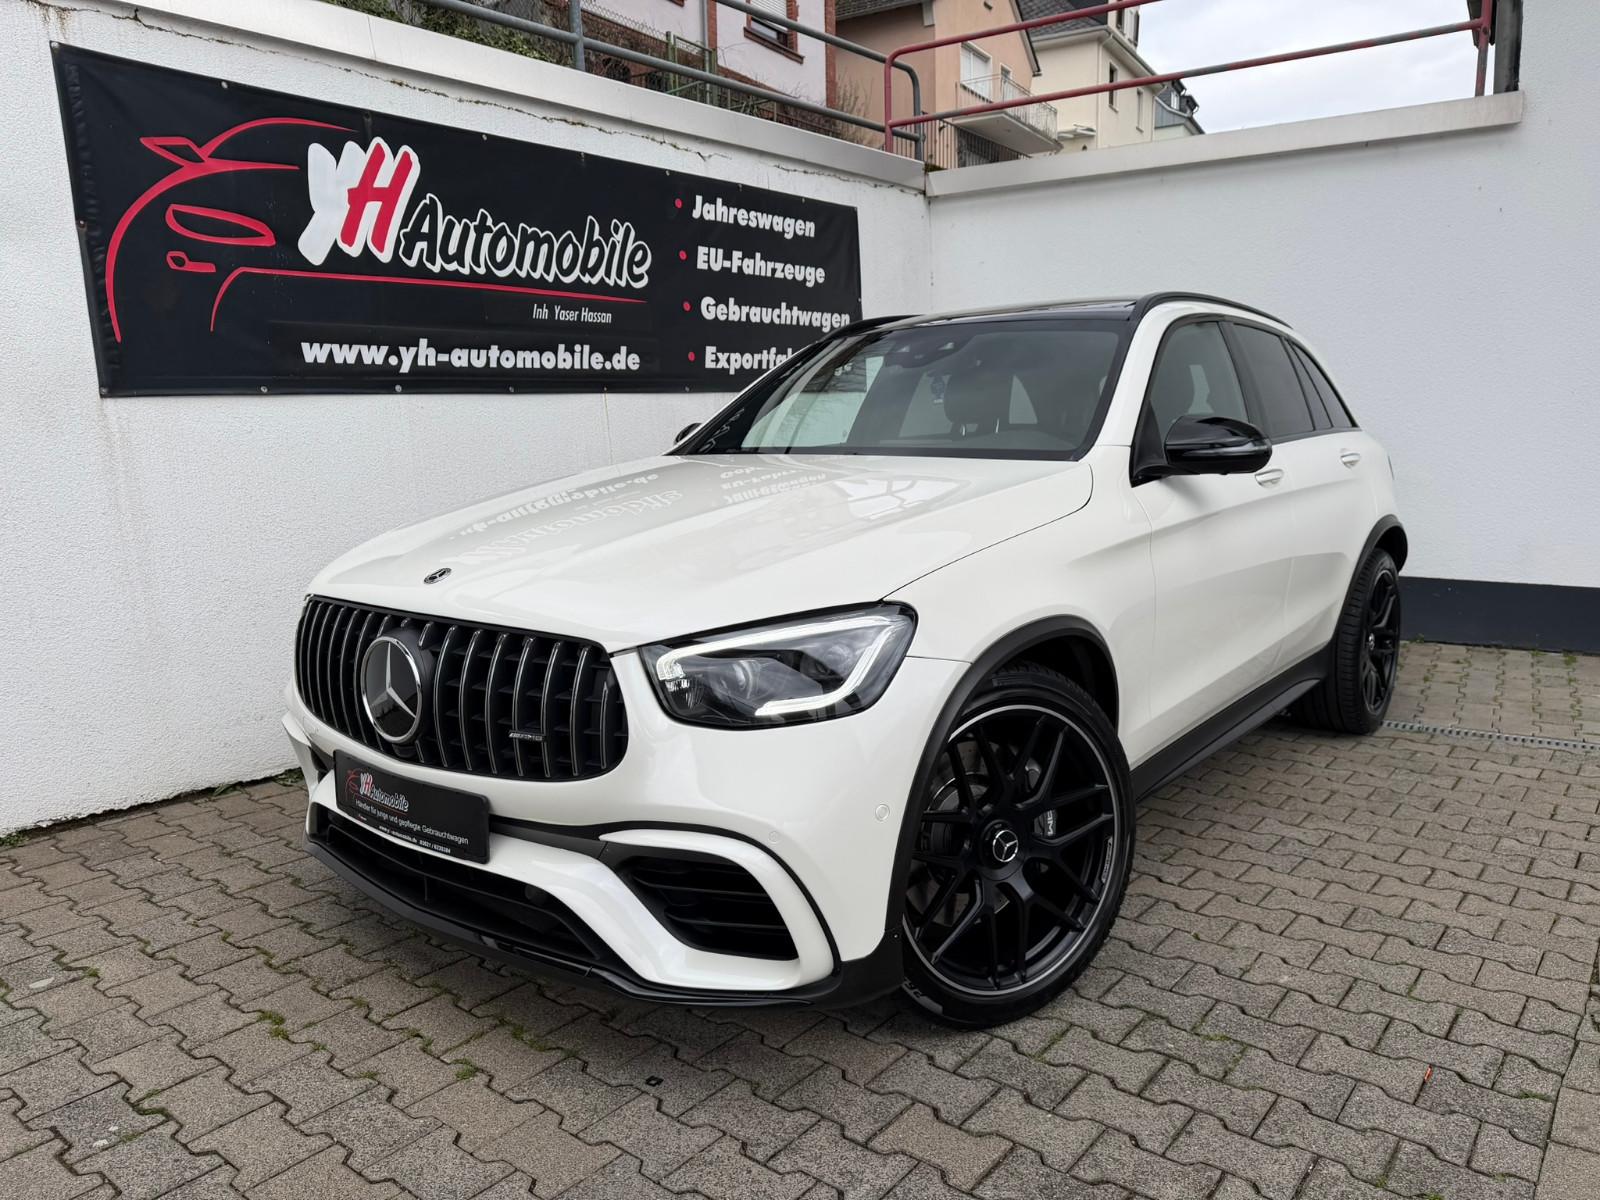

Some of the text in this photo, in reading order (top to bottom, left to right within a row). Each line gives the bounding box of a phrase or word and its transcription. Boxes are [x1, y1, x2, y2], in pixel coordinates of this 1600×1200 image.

[297, 136, 652, 288] YH Automobile
[692, 195, 815, 239] Jahreswagen
[696, 246, 826, 287] EU-Fahrzeuge
[554, 305, 579, 321] Yaser
[580, 307, 612, 323] Hassan
[700, 296, 850, 333] Gebrauchtwagen
[301, 338, 640, 373] www.yh-automobile.de
[371, 784, 409, 812] Automobile
[421, 824, 469, 845] Gebrauchtwagen
